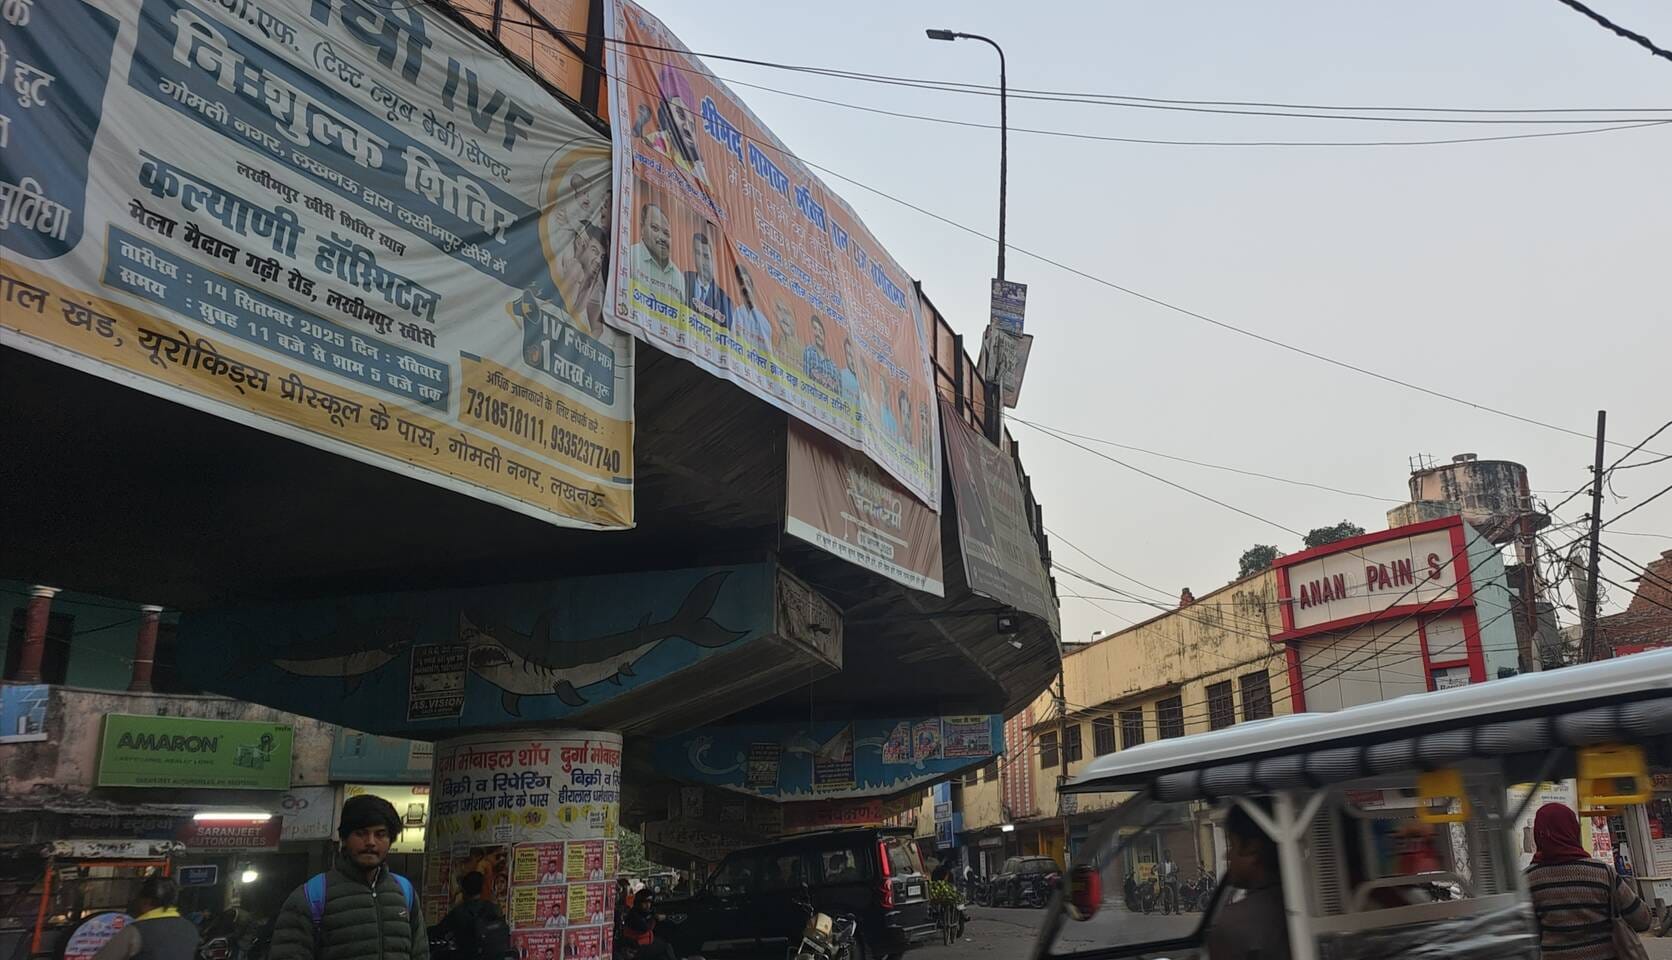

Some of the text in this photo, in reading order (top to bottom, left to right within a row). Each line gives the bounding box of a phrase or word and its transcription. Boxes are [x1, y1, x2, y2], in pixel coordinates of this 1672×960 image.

[158, 76, 230, 126] गोमती
[234, 119, 286, 158] नगर,
[397, 205, 464, 258] लखीमपुर
[236, 160, 299, 203] लखीमपुर
[304, 194, 335, 221] खीरी
[340, 210, 375, 241] शिविर
[402, 145, 518, 244] शिविर
[138, 148, 443, 324] कल्याणी हॉस्पिटल
[129, 198, 179, 239] मेला
[184, 219, 240, 265] मैदान
[288, 269, 317, 302] रोड,
[326, 288, 394, 335] लखीमपुर
[398, 321, 437, 348] खीरी
[120, 240, 179, 280] तारीख
[204, 279, 227, 302] 14
[233, 288, 295, 327] सितम्बर
[300, 320, 345, 348] 2025
[350, 335, 379, 362] दिन
[397, 355, 442, 382] रविवार
[633, 287, 678, 320] आयोजक
[120, 265, 167, 300] समय
[199, 299, 240, 330] सुबह
[248, 322, 270, 342] 11
[276, 330, 306, 357] बजे
[311, 345, 326, 363] से
[331, 352, 366, 377] शाम
[371, 367, 381, 382] 5
[387, 372, 414, 393] बजे
[418, 384, 443, 402] तक
[553, 353, 585, 388] लाख
[60, 298, 123, 347] खंड,
[137, 326, 271, 396] यूरोकिड्स
[277, 371, 363, 429] प्रीस्कूल
[370, 402, 392, 432] के
[397, 418, 440, 455] पास,
[448, 434, 503, 475] गोमती
[507, 460, 545, 494] नगर,
[550, 425, 621, 475] 9335237740
[117, 732, 220, 753] AMARON
[457, 746, 515, 773] मोबाइल
[518, 743, 550, 768] शॉप
[560, 740, 589, 773] दुर्गा
[498, 792, 514, 809] गेट
[516, 791, 527, 808] के
[530, 793, 549, 808] पास
[190, 836, 267, 848] AUTOMOBILES
[197, 827, 262, 837] SARANJEET
